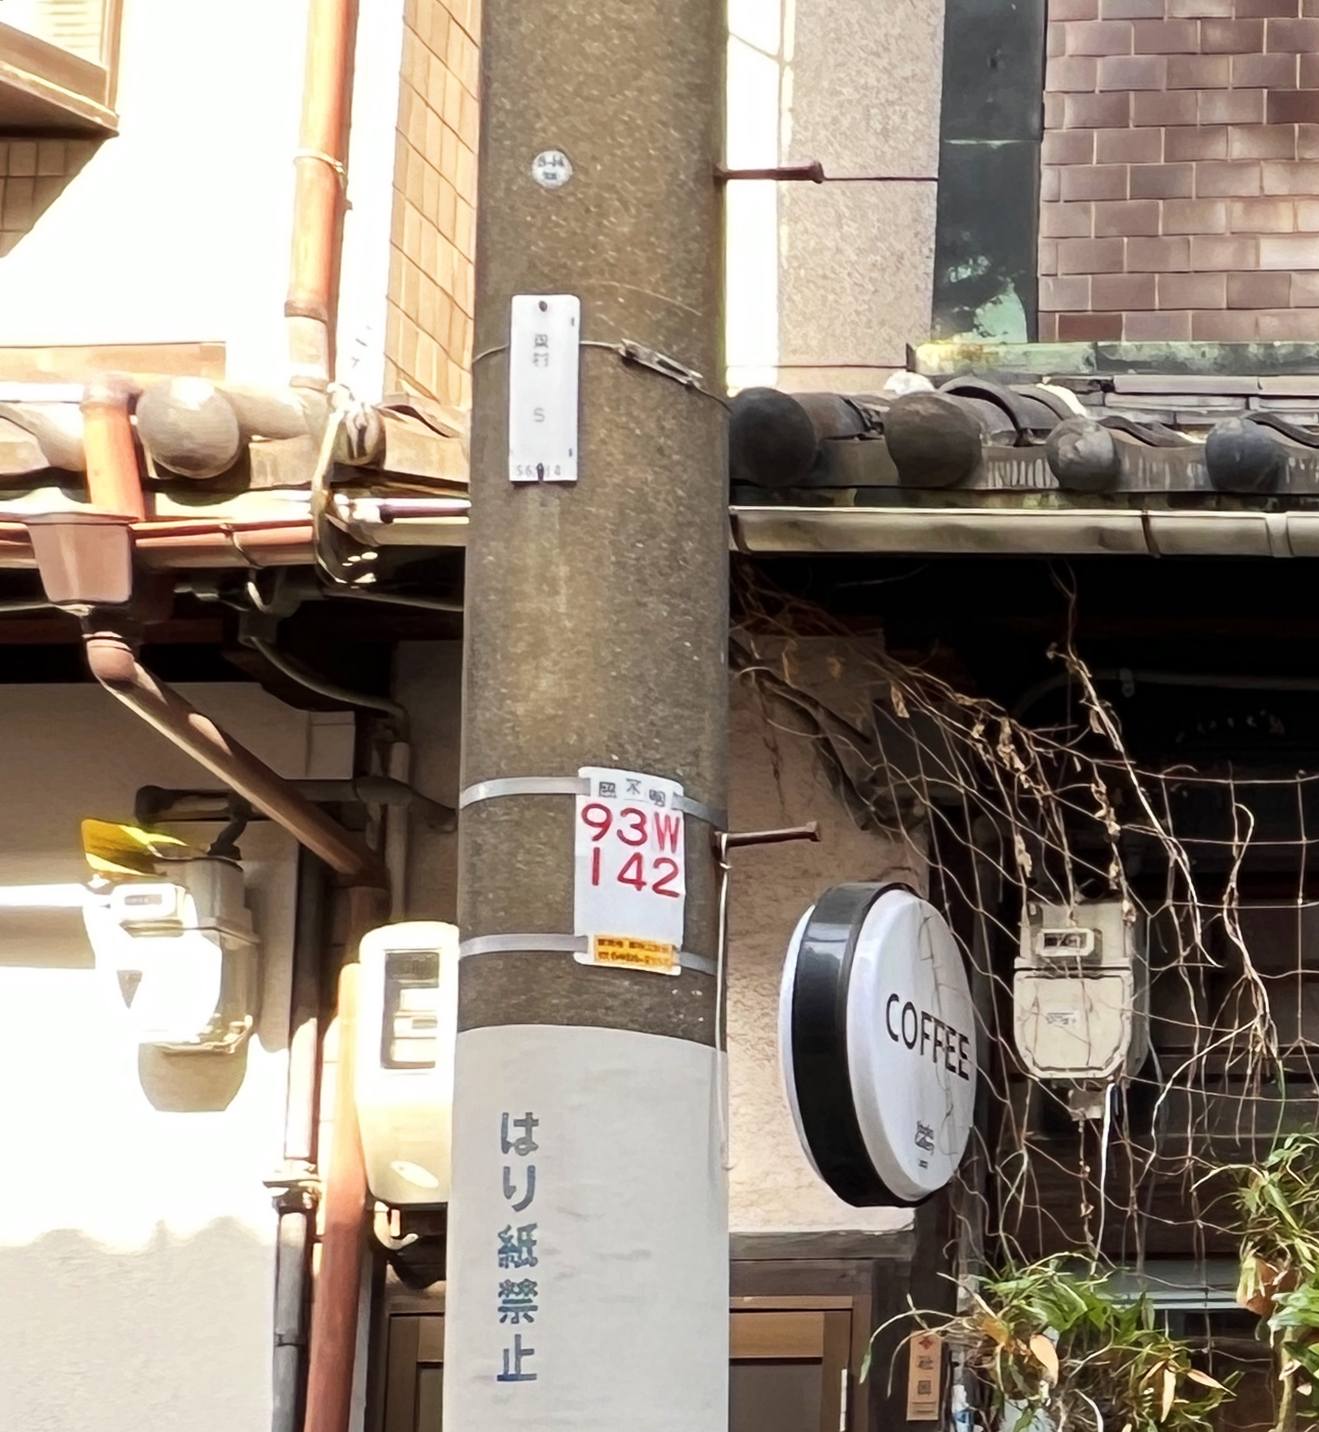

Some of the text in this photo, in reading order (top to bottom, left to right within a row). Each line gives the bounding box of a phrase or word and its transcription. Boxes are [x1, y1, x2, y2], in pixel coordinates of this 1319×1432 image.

[582, 803, 680, 855] 93W
[592, 847, 680, 898] 142
[885, 993, 970, 1081] COFFEE
[497, 1112, 540, 1382] はり紙禁止
